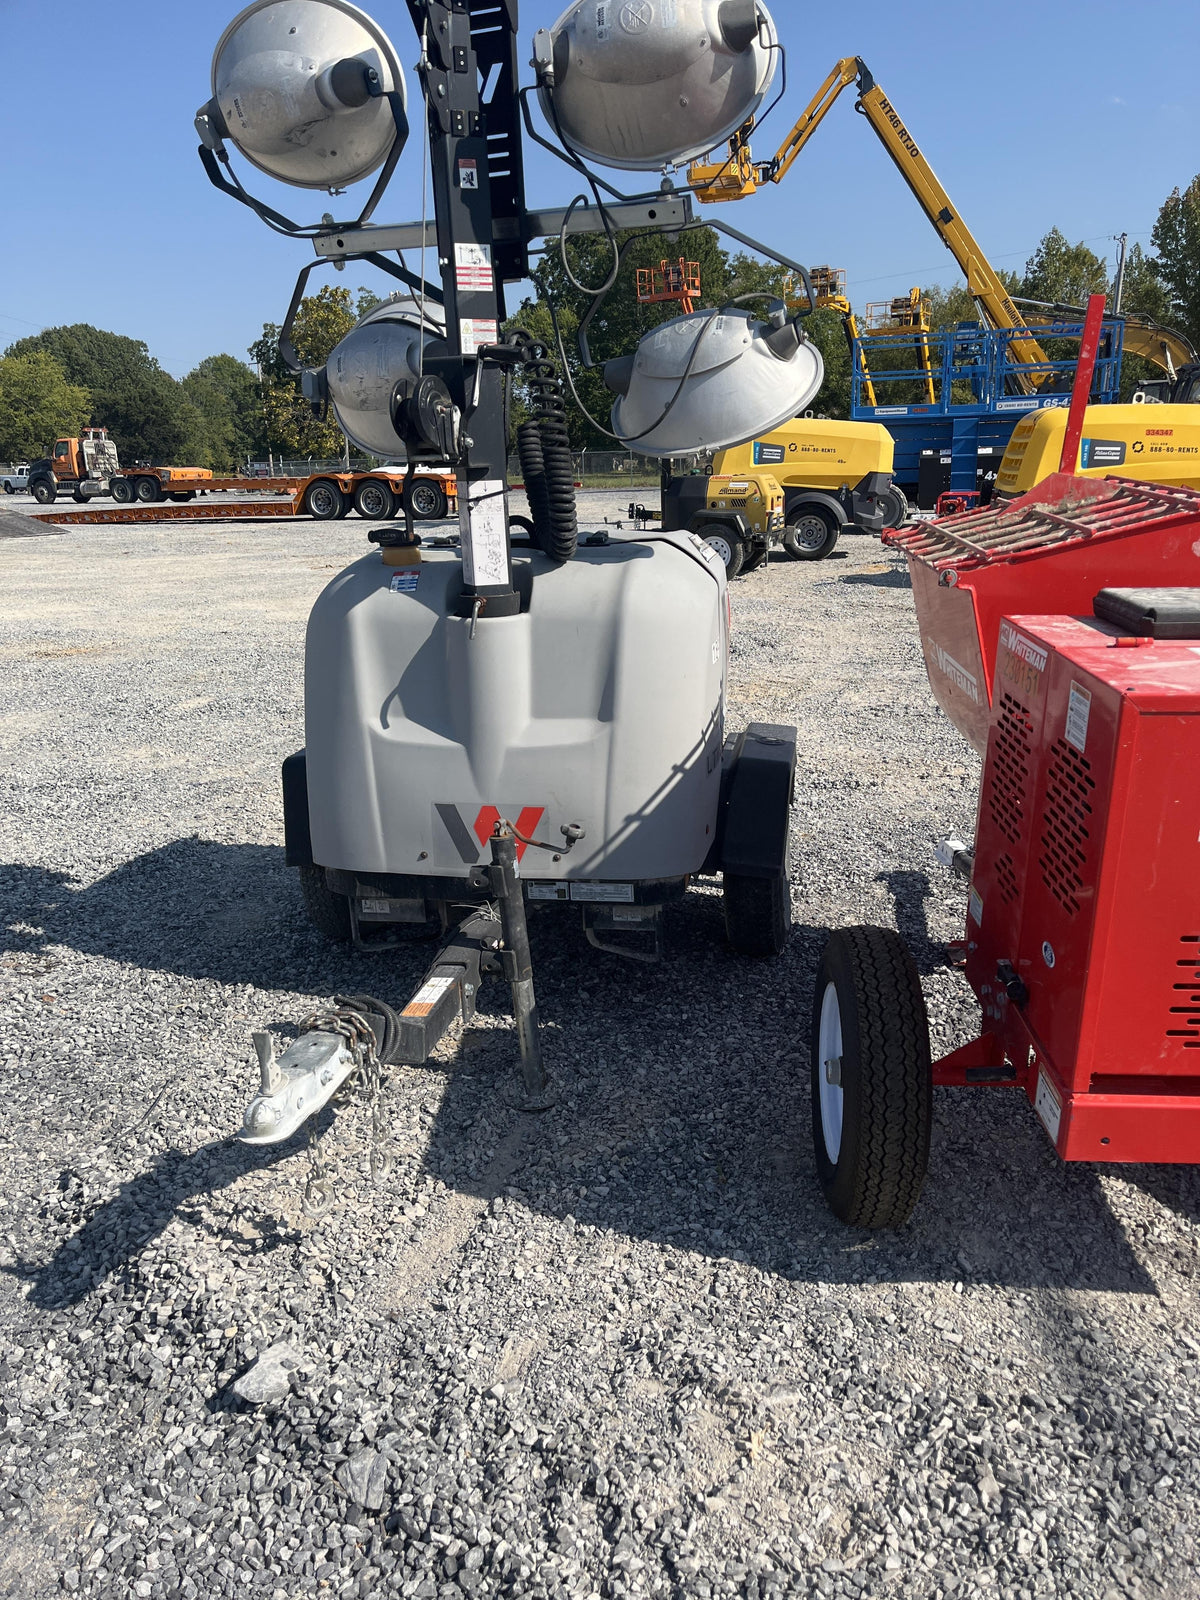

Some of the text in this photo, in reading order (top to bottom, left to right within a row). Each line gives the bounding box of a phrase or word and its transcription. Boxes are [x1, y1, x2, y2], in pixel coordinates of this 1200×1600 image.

[879, 98, 920, 158] HT46 RTJO
[1001, 297, 1022, 329] Haulotte
[1043, 397, 1072, 408] GS-4
[1149, 446, 1199, 454] 888-80-RENTS
[719, 487, 748, 495] Allmand
[1008, 628, 1047, 673] WHITEMAN
